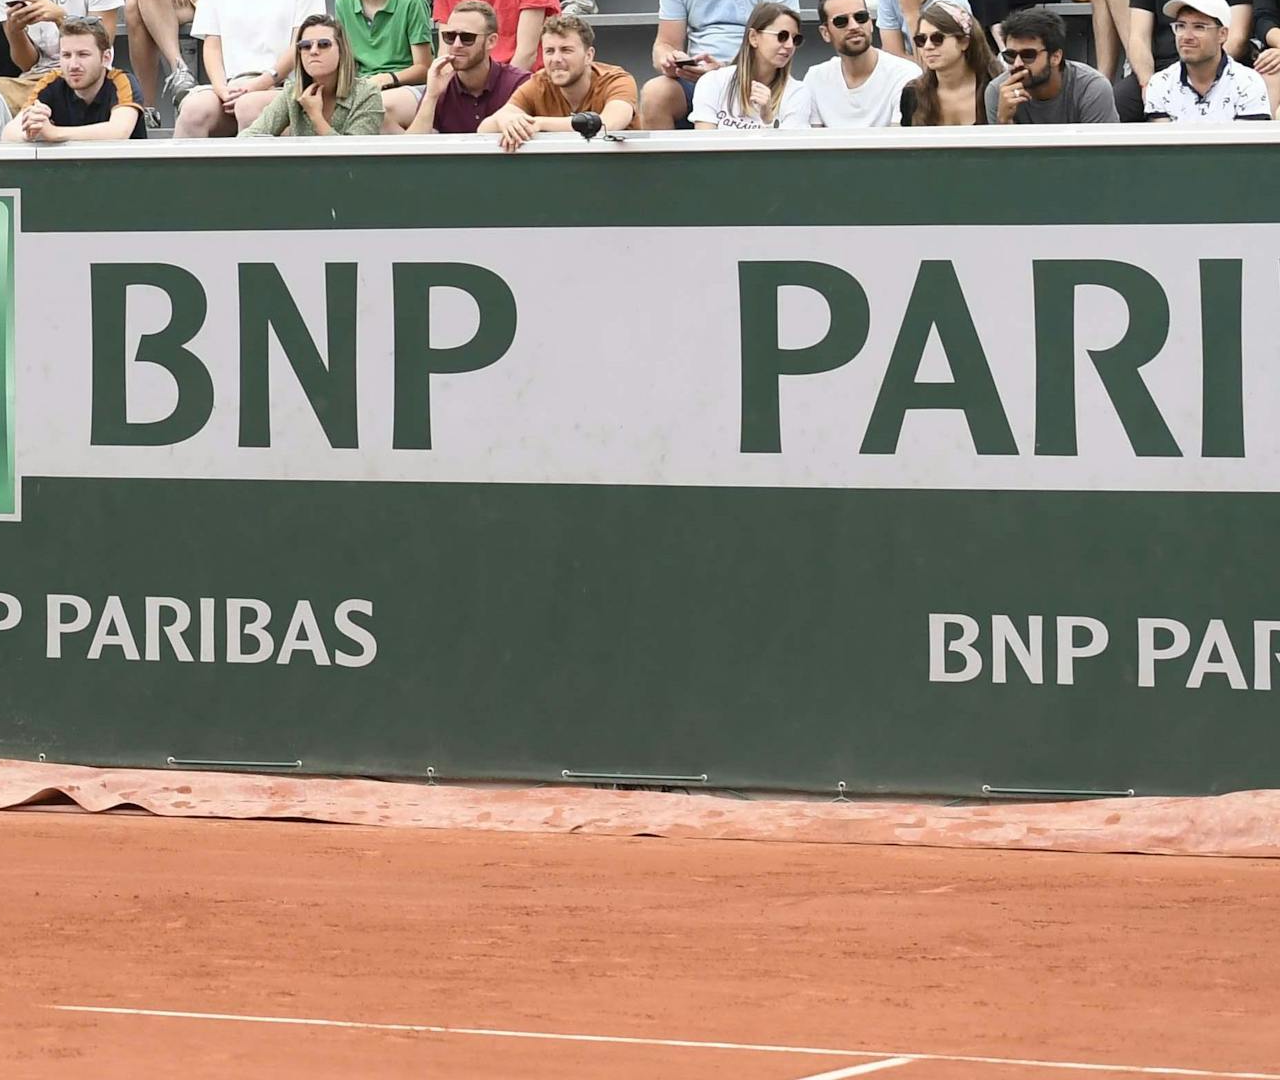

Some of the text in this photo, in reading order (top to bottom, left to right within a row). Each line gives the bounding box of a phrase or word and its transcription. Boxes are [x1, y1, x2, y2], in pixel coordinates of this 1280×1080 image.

[90, 258, 1246, 459] BNP PARI
[46, 593, 378, 668] PARIBAS
[928, 613, 1109, 685] BNP
